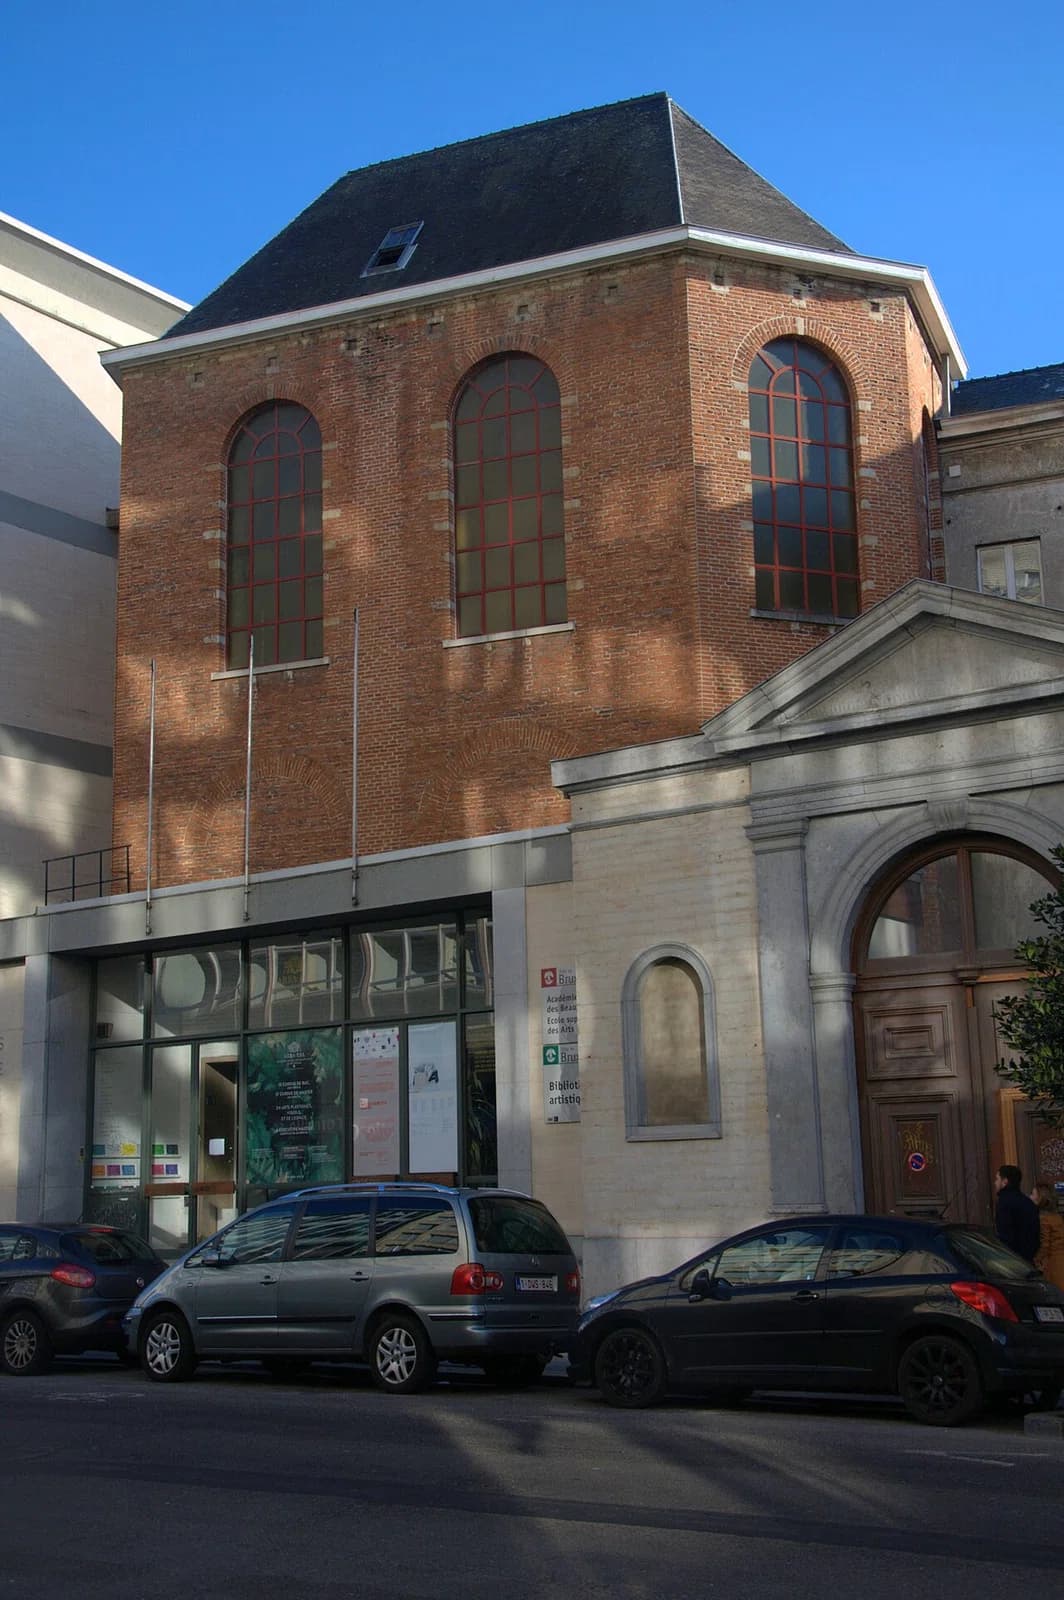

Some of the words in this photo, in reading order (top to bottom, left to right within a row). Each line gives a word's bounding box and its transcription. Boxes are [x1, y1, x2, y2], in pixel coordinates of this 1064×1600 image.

[546, 1005, 559, 1013] des
[547, 1026, 559, 1034] des
[560, 1025, 575, 1033] Arts
